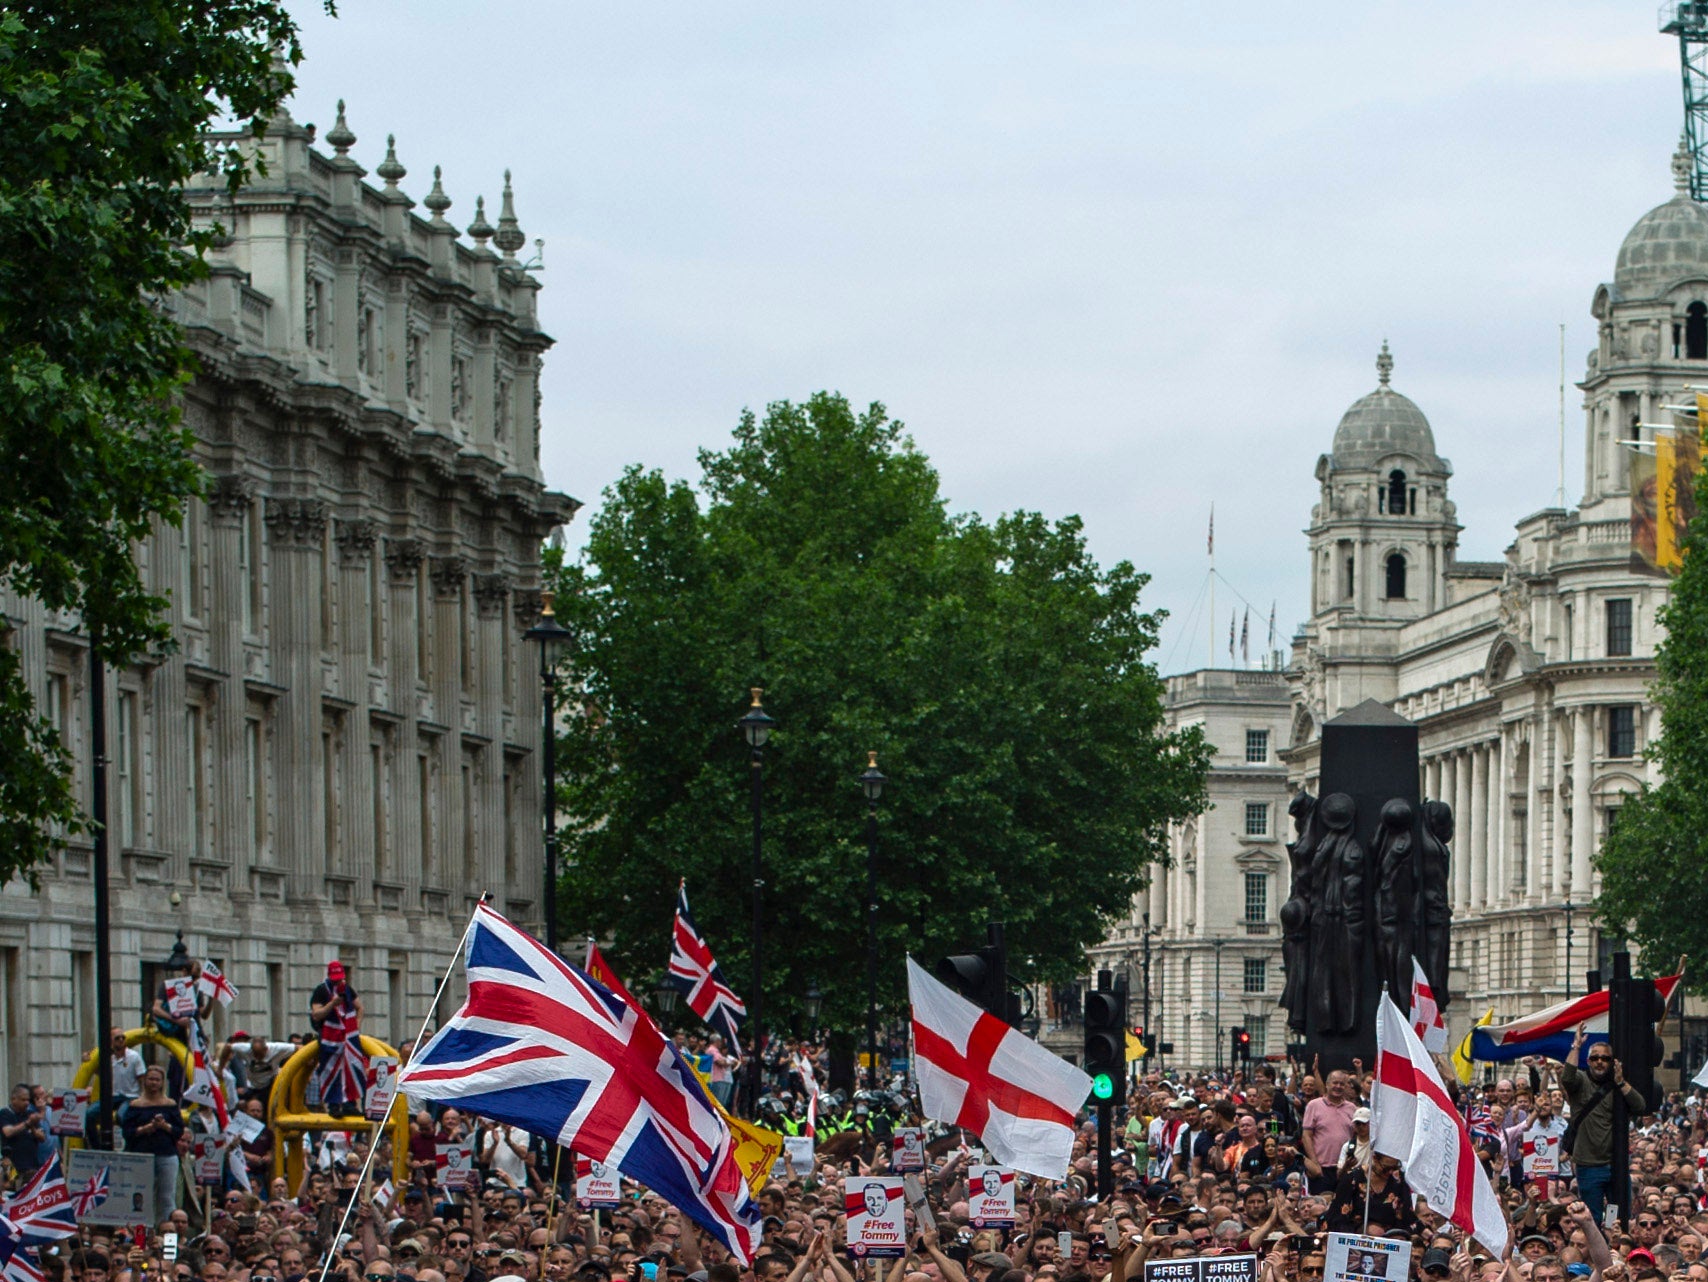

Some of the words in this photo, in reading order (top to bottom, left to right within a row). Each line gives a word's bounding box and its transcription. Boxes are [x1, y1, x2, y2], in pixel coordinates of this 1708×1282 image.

[589, 1180, 613, 1188] #Free
[587, 1187, 616, 1198] Tommy
[19, 1203, 35, 1215] Our
[37, 1190, 63, 1206] Boys
[982, 1199, 1007, 1207] #Free
[980, 1207, 1011, 1216] Tommy
[864, 1219, 894, 1230] #Free
[860, 1229, 899, 1242] Tommy
[1153, 1265, 1193, 1277] #FREE
[1209, 1261, 1249, 1273] #FREE
